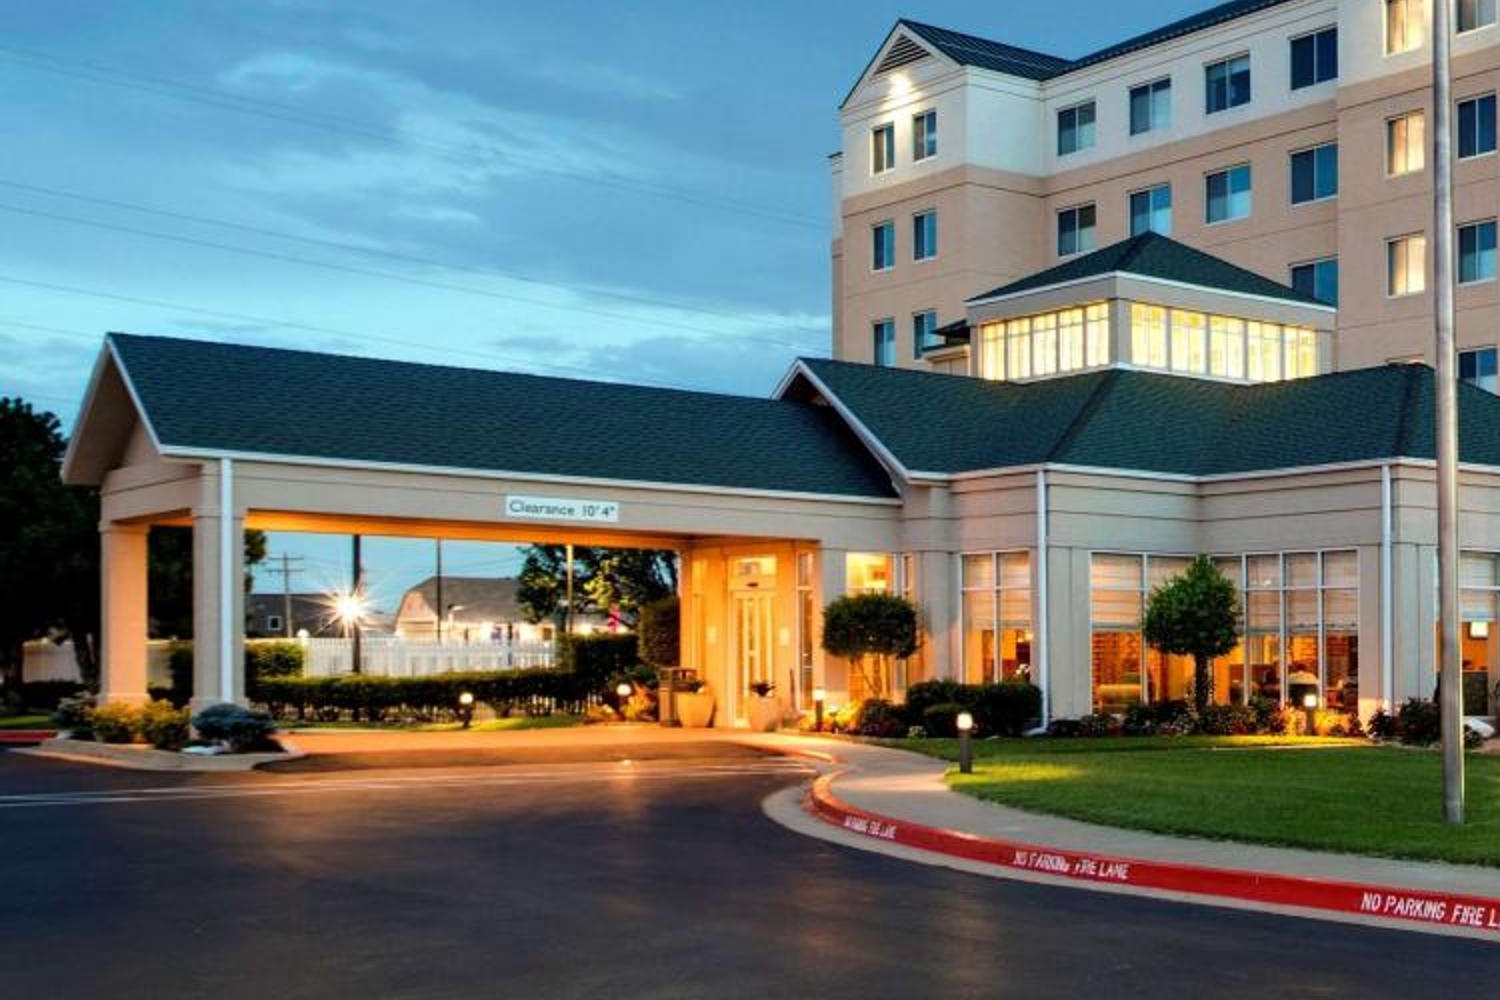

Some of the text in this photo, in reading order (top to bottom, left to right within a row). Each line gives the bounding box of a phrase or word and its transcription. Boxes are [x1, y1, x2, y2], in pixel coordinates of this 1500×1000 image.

[509, 499, 575, 516] Clearance
[1098, 861, 1130, 880] LANE
[1361, 892, 1381, 912] NO
[1384, 895, 1446, 921] PARKING
[1451, 904, 1486, 925] FIRE
